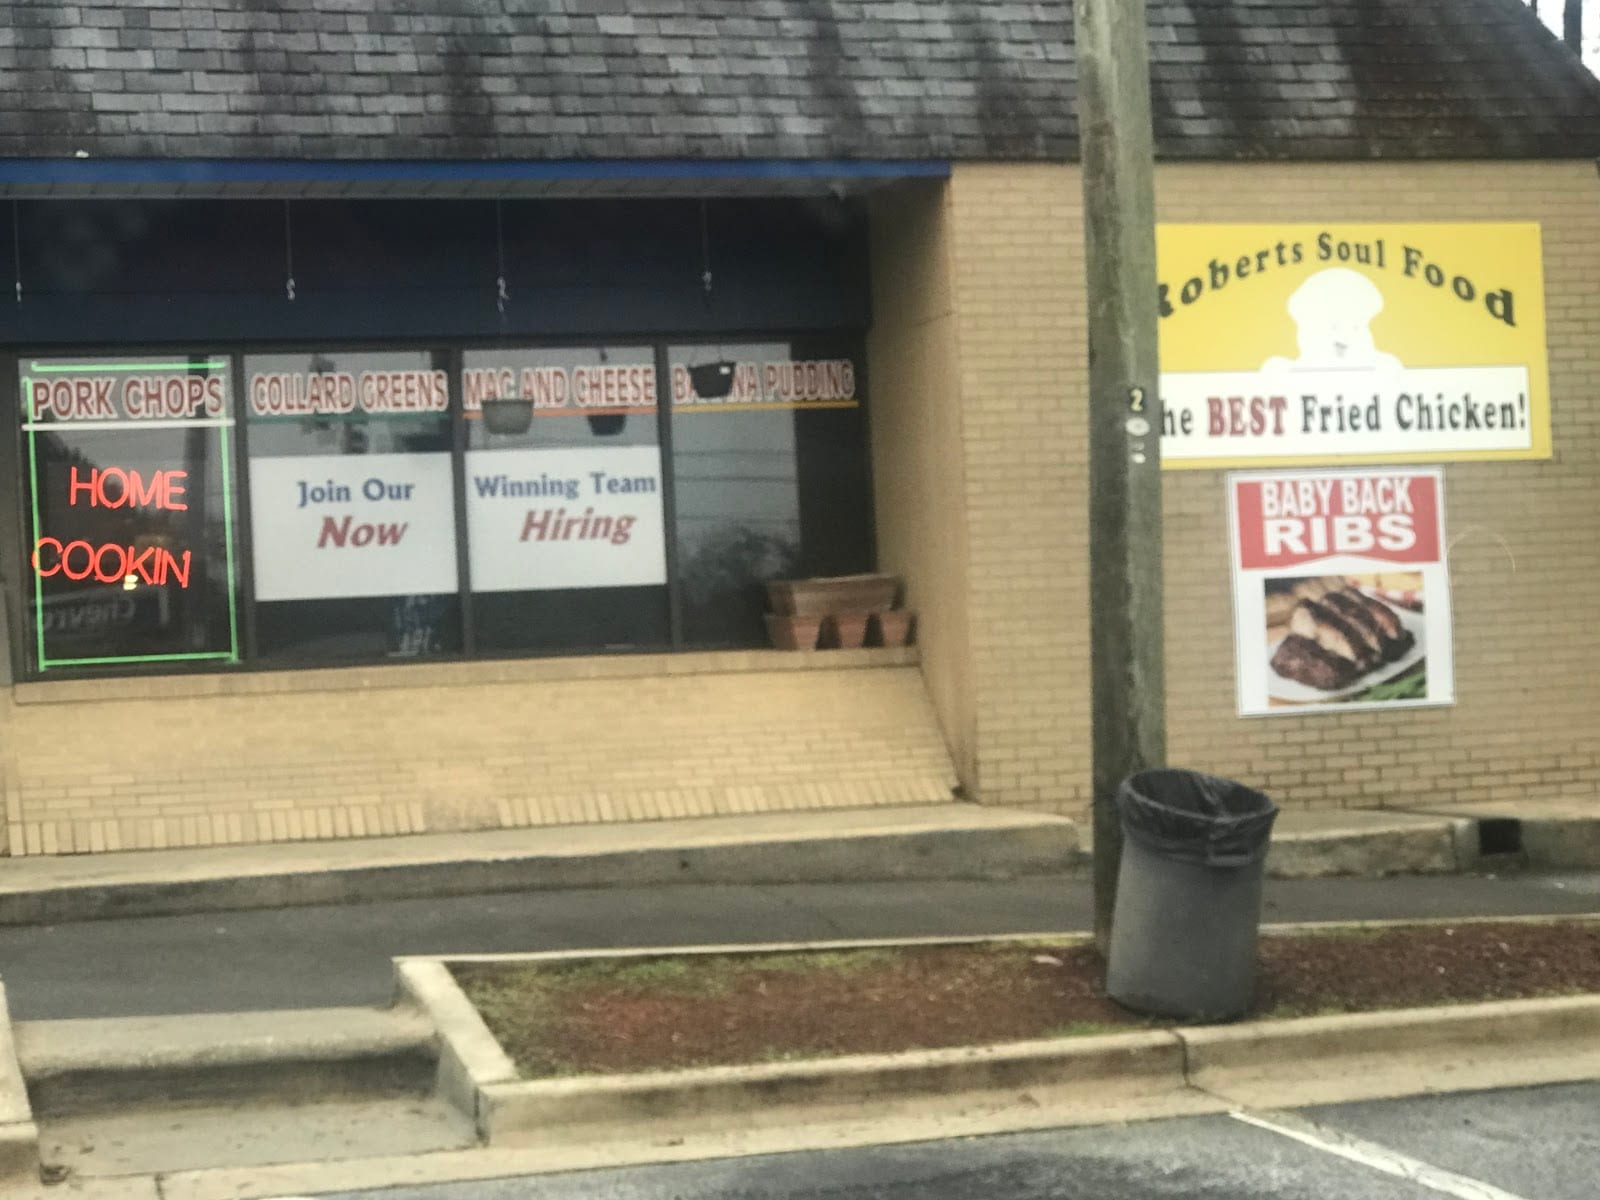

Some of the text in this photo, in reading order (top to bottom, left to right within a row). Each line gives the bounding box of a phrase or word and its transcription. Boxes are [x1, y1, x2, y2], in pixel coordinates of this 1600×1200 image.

[1317, 232, 1385, 267] Soul
[1402, 245, 1517, 327] Food
[32, 377, 223, 420] PORK CHOPS
[252, 370, 449, 415] COLLARD GREENS
[463, 364, 656, 409] MAC AND CHEESE
[765, 360, 855, 402] PUDDING
[1131, 388, 1143, 411] 2
[1158, 393, 1527, 438] he BEST Fried Chicken!
[70, 466, 188, 511] HOME
[298, 478, 415, 507] Join Our
[474, 470, 657, 501] Winning Team
[1262, 477, 1415, 518] BABY BACK
[317, 516, 408, 548] Now
[519, 507, 637, 544] Hiring
[1264, 515, 1417, 556] RIBS
[32, 537, 191, 588] COOKIN
